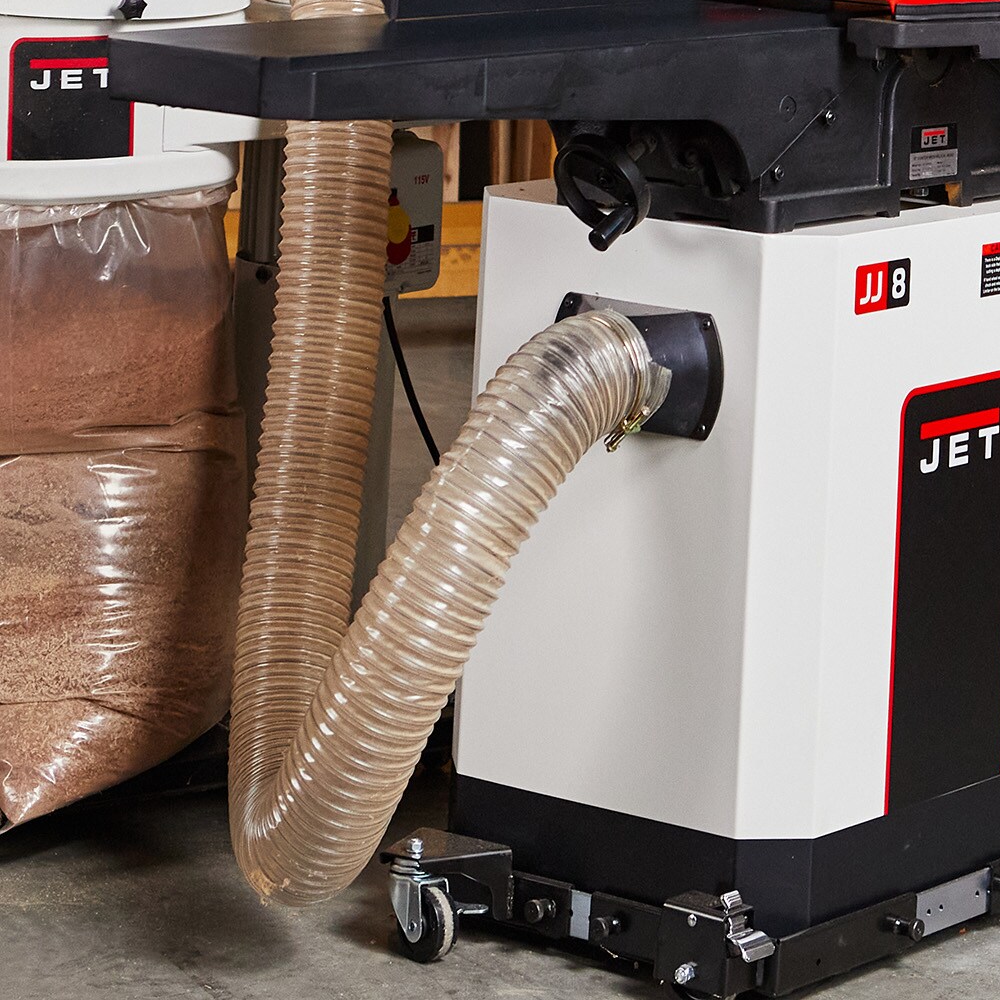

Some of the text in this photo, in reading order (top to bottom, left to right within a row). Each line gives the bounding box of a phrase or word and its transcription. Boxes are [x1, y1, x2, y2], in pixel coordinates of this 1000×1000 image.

[30, 68, 109, 90] JET
[923, 135, 946, 146] JET
[414, 175, 430, 185] 115V
[920, 424, 1000, 475] JET
